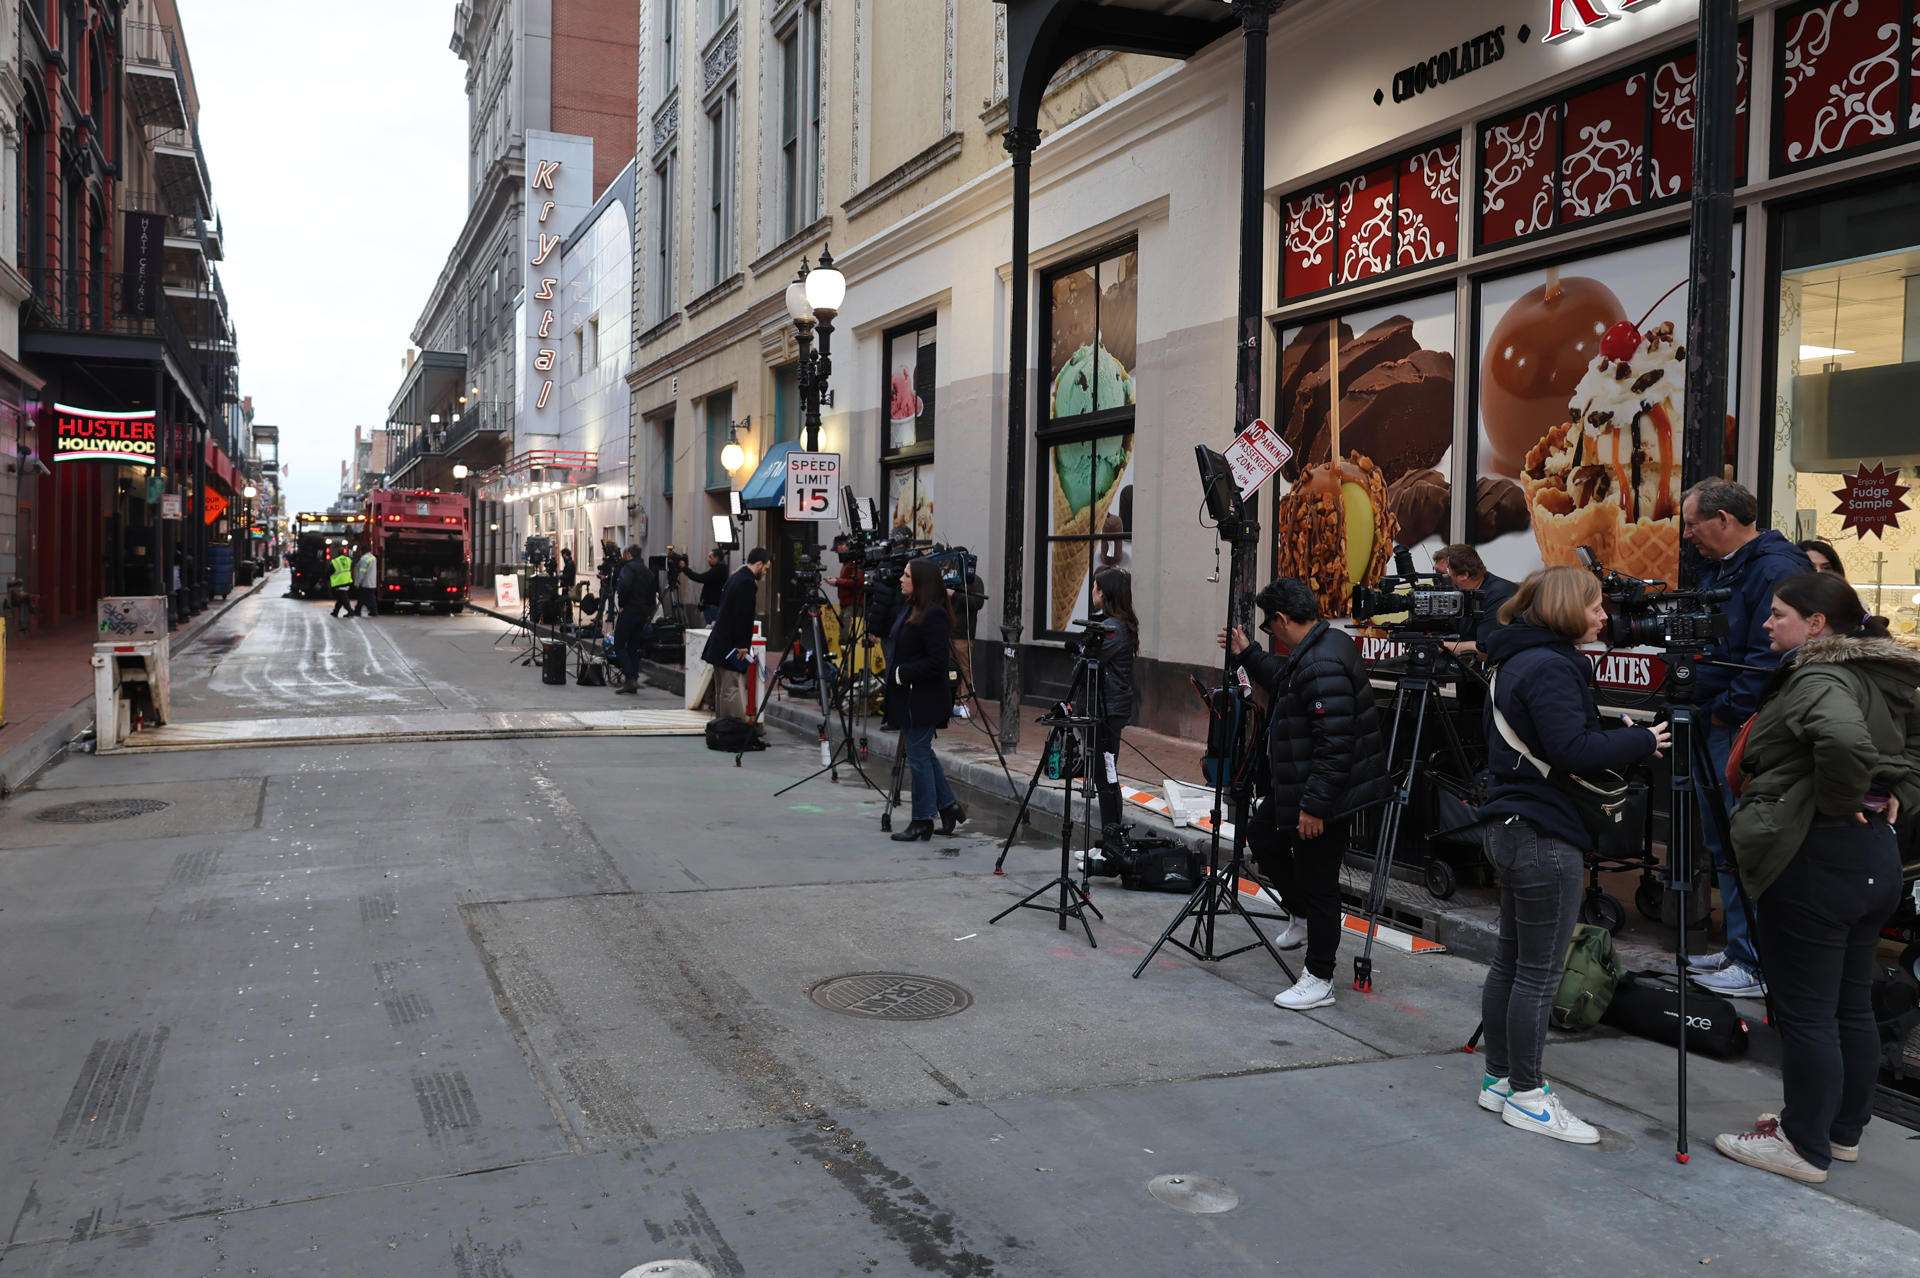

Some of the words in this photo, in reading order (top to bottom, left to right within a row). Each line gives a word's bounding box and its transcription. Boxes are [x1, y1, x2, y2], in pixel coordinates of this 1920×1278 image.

[1392, 25, 1505, 104] CHOCOLATES
[140, 217, 149, 254] HYATT
[137, 257, 147, 311] CERC
[531, 160, 561, 409] Krystal
[58, 418, 156, 439] HUSTLER
[1248, 424, 1265, 441] NO
[58, 437, 156, 454] HOLLYWOOD
[1259, 434, 1286, 463] PARKING
[791, 460, 836, 472] SPEED
[1235, 454, 1257, 475] ZONE
[1237, 438, 1273, 475] PASSENGER
[796, 474, 830, 485] LIMIT
[1857, 479, 1878, 487] Enjoy
[796, 487, 829, 513] 15
[1852, 486, 1890, 499] Fudge
[1849, 499, 1894, 511] Sample
[1361, 636, 1412, 661] APPLE
